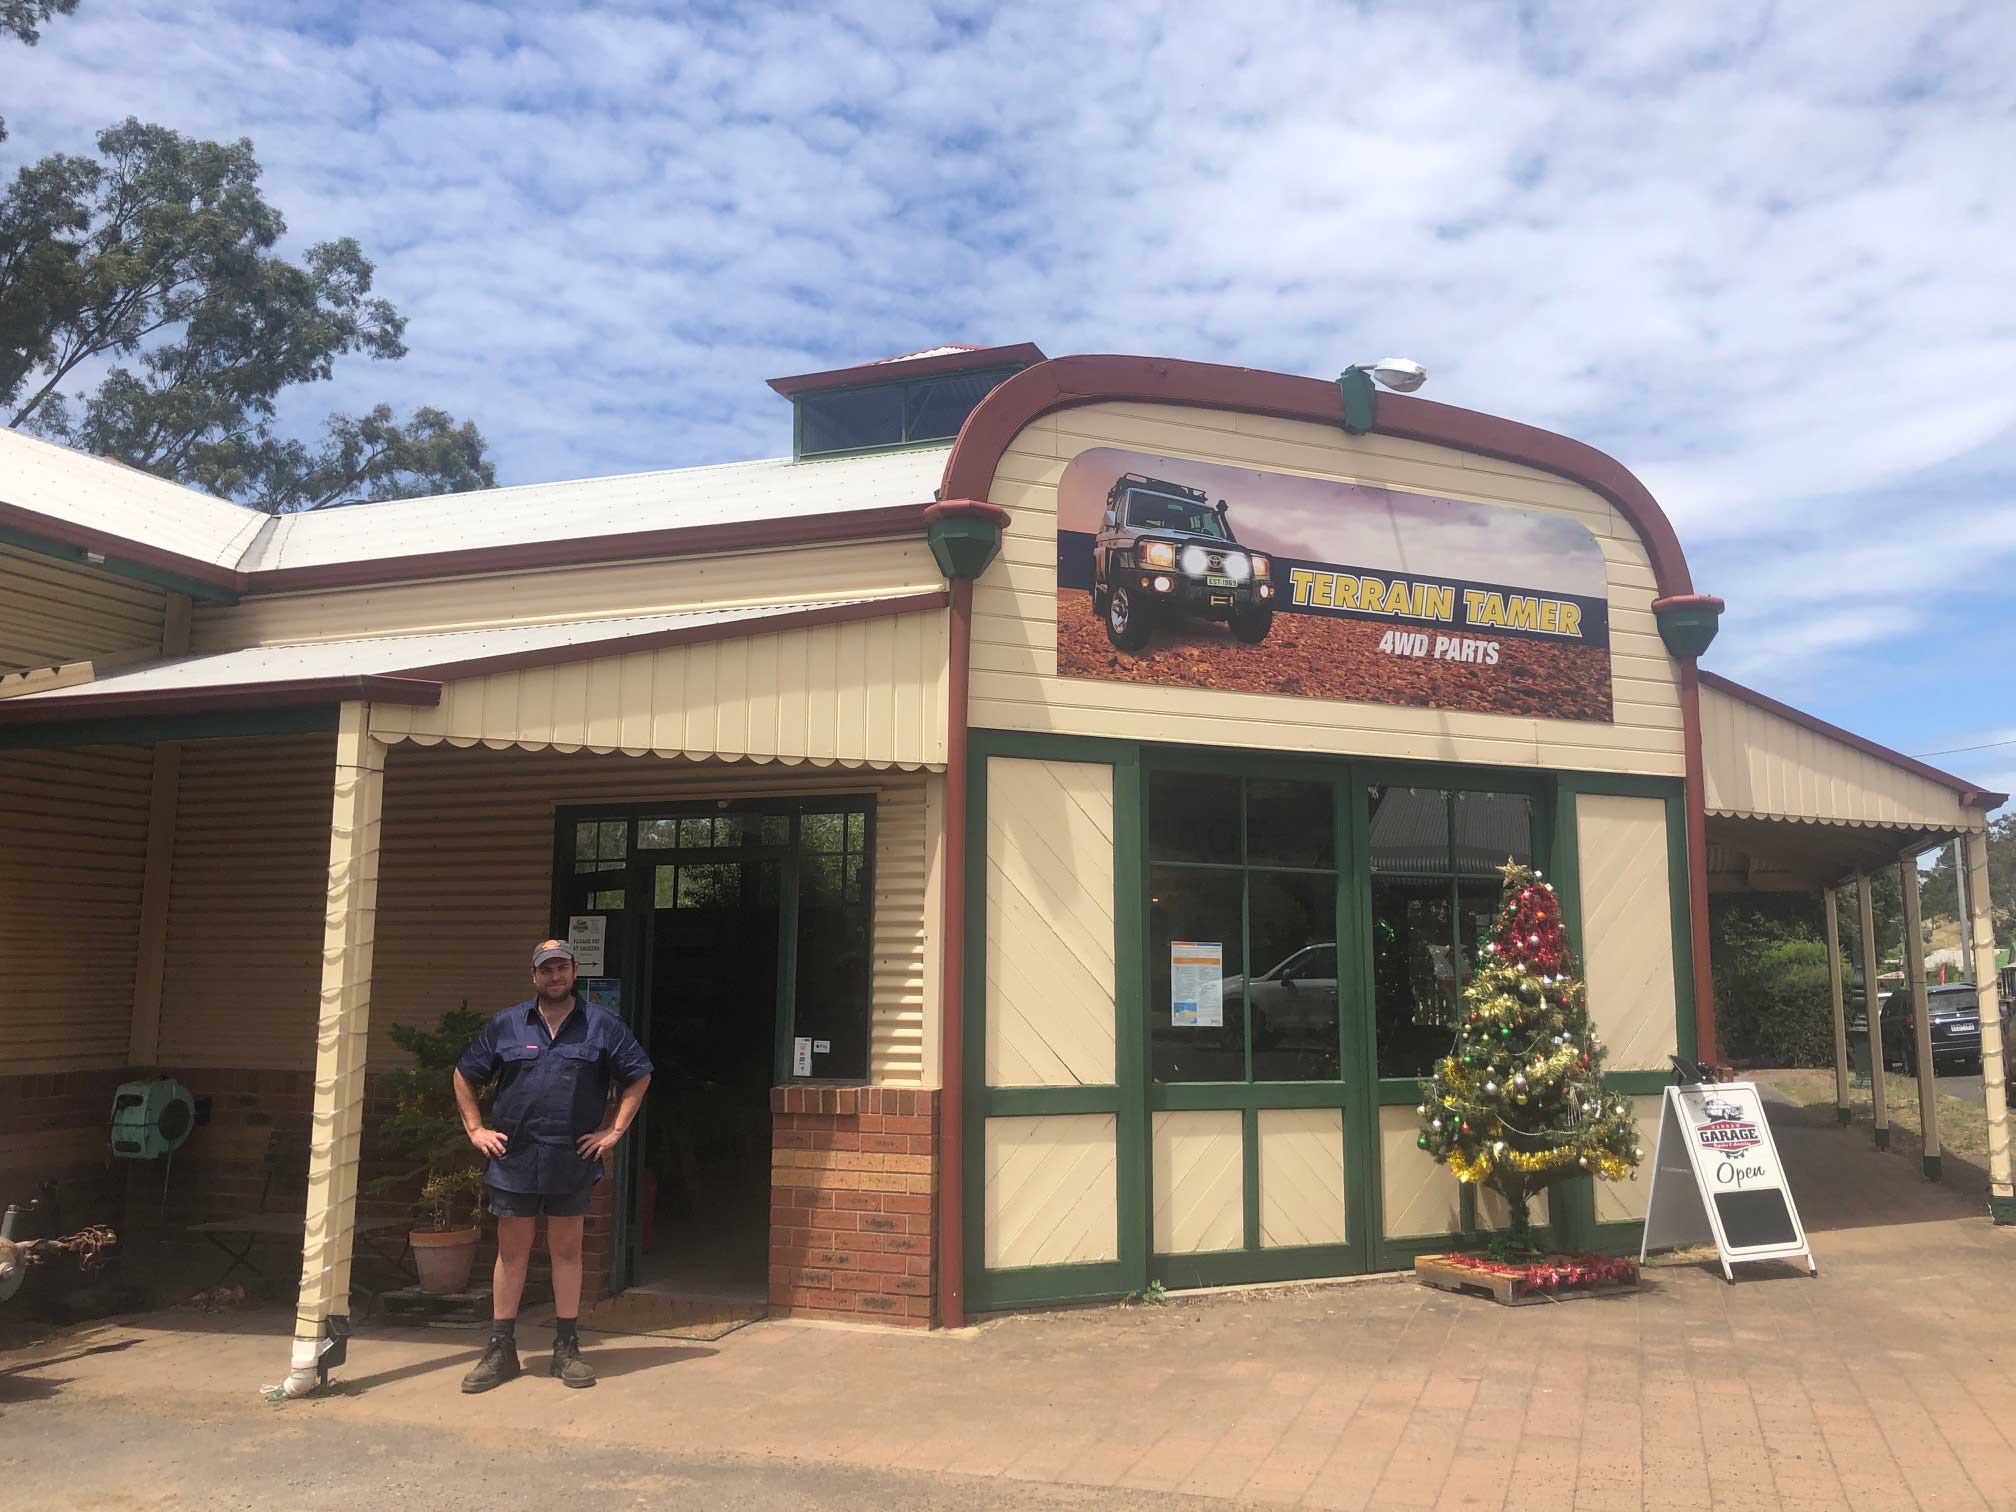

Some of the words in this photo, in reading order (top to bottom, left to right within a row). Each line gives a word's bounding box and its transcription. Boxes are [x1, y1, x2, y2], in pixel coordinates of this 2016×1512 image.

[1290, 568, 1455, 622] TERRAIN
[1464, 589, 1583, 637] TAMER
[1379, 631, 1428, 657] 4WD
[1434, 635, 1499, 665] PARTS
[1700, 1128, 1758, 1143] GARAGE
[1716, 1162, 1765, 1188] Open
